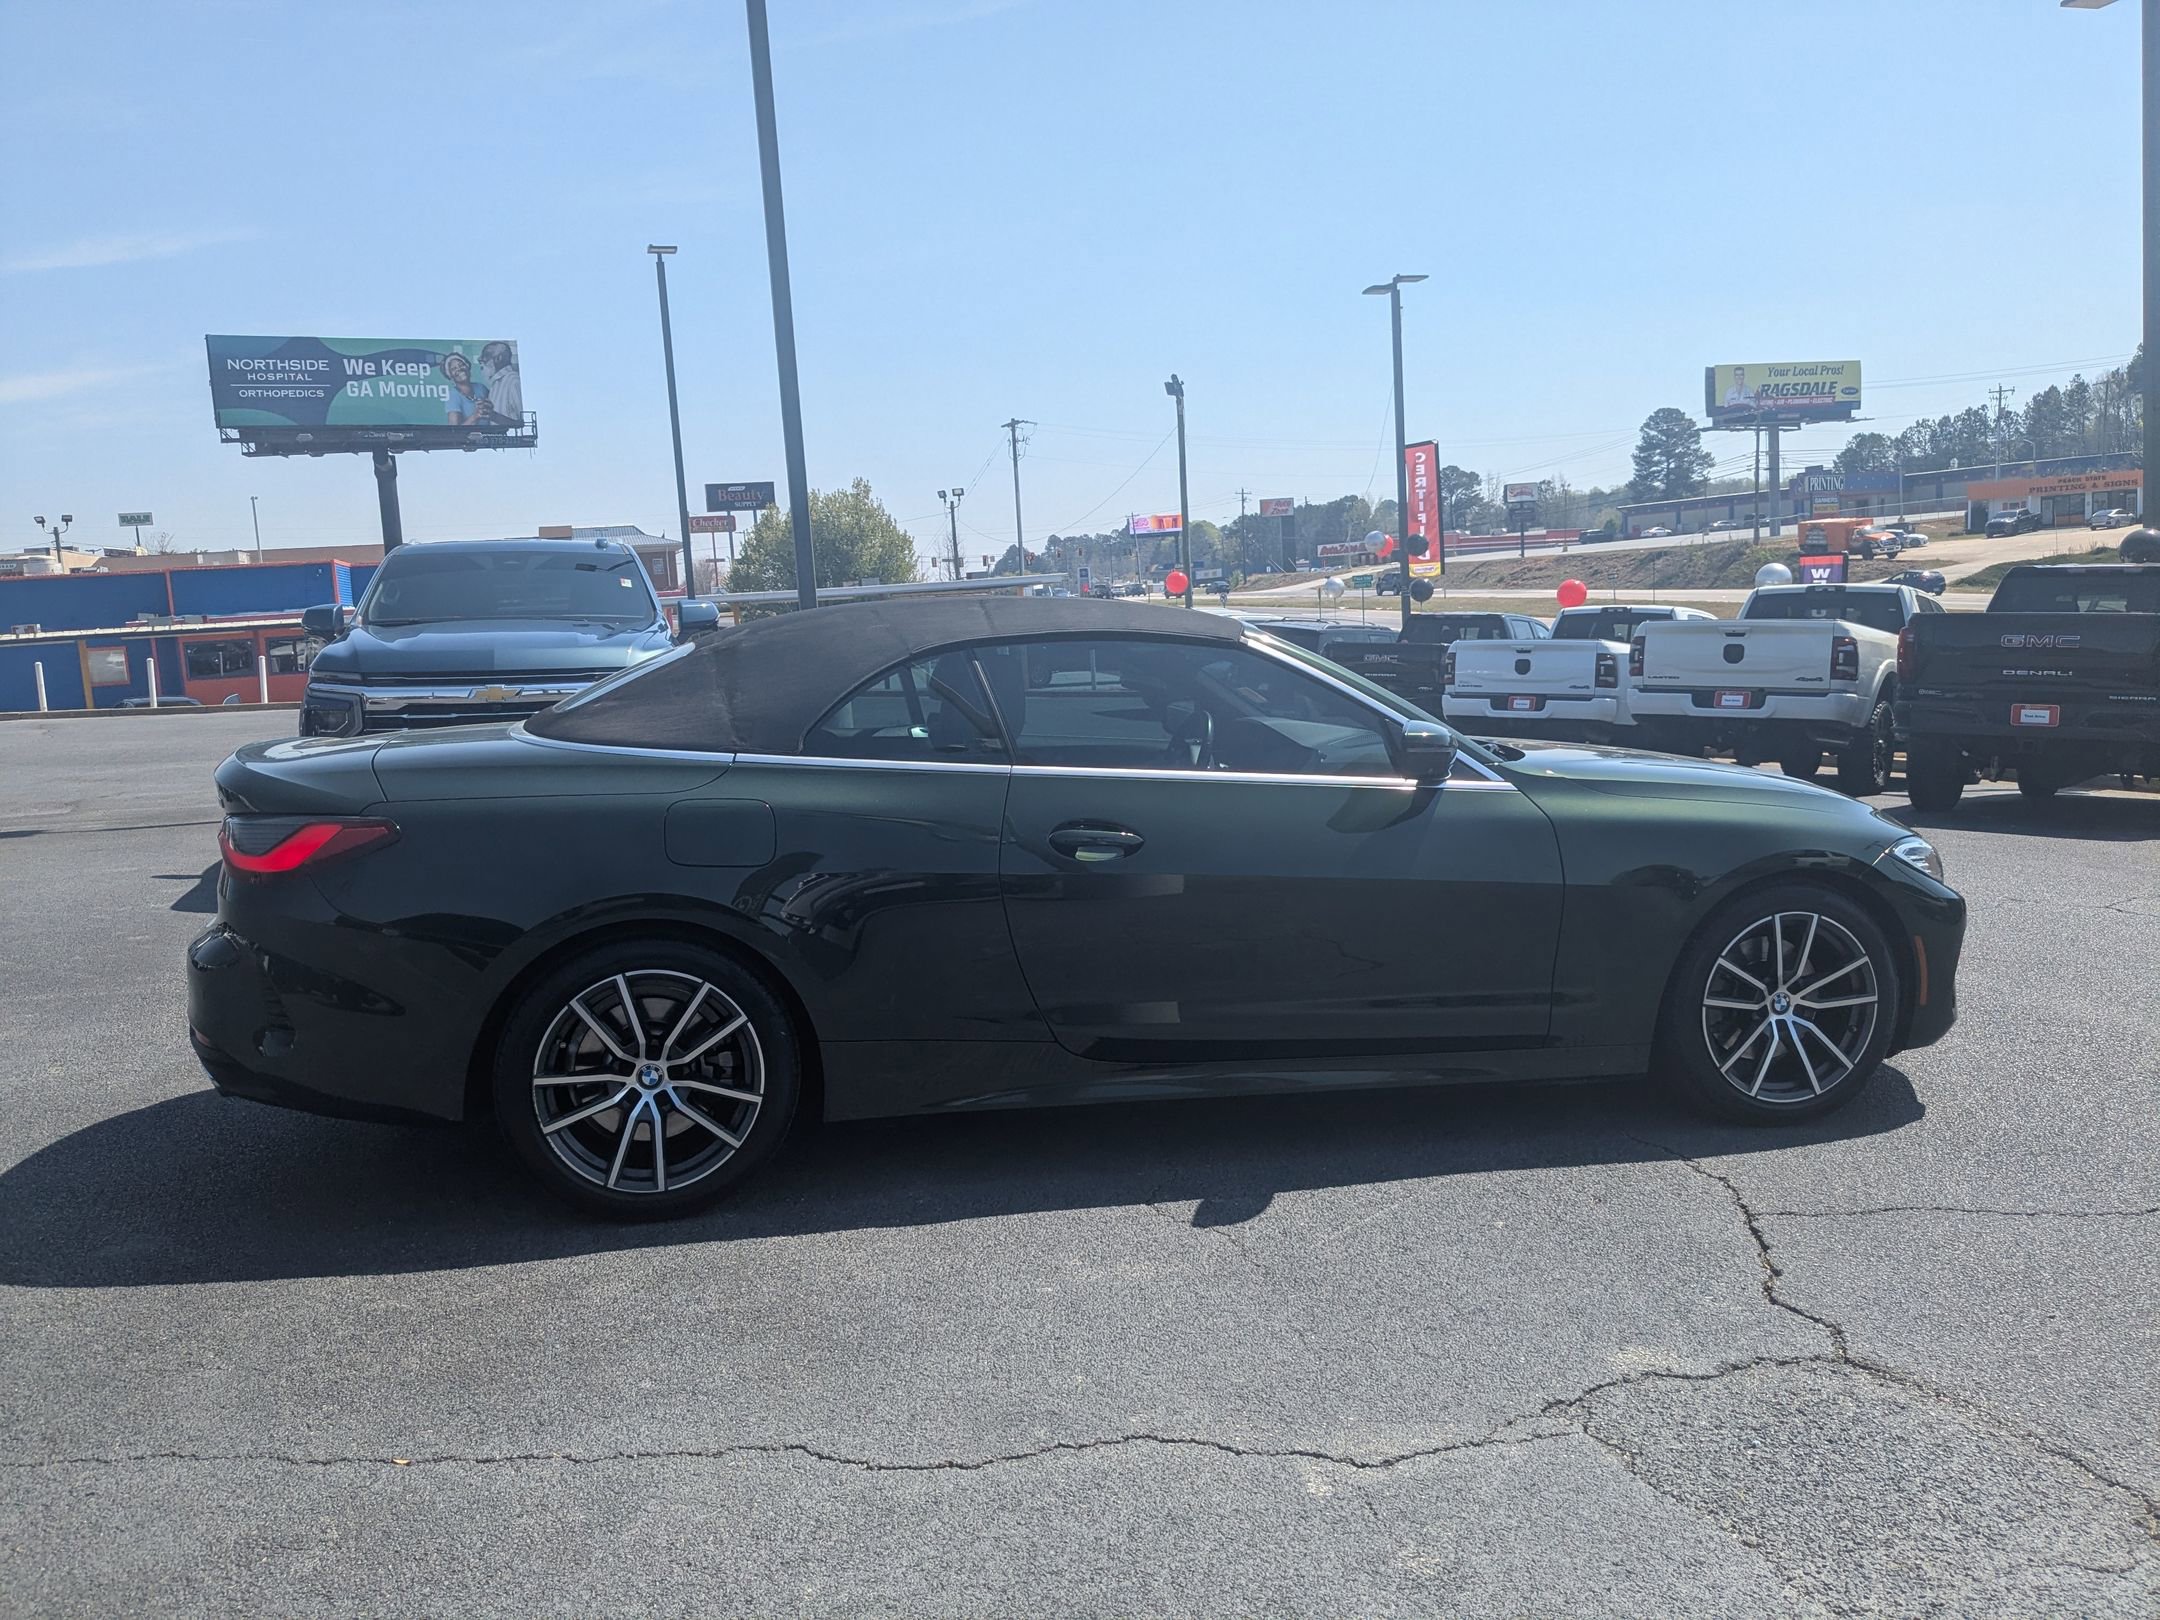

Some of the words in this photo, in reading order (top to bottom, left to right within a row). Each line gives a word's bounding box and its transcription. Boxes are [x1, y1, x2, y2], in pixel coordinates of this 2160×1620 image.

[227, 358, 330, 372] NORTHSIDE
[343, 358, 376, 375] We
[381, 359, 431, 379] Keep
[1768, 367, 1791, 378] Your
[1792, 365, 1818, 377] Local
[1820, 364, 1844, 376] Pros!
[247, 372, 313, 381] HOSPITAL
[238, 389, 325, 399] ORTHOPEDICS
[346, 381, 374, 397] GA
[380, 381, 450, 402] Moving
[1759, 381, 1838, 397] RAGSDALE
[1809, 476, 1844, 491] PRINTING
[2028, 483, 2086, 494] PRINTING
[2103, 479, 2139, 488] SIGNS
[718, 489, 764, 502] Beauty
[2000, 634, 2081, 649] GMC
